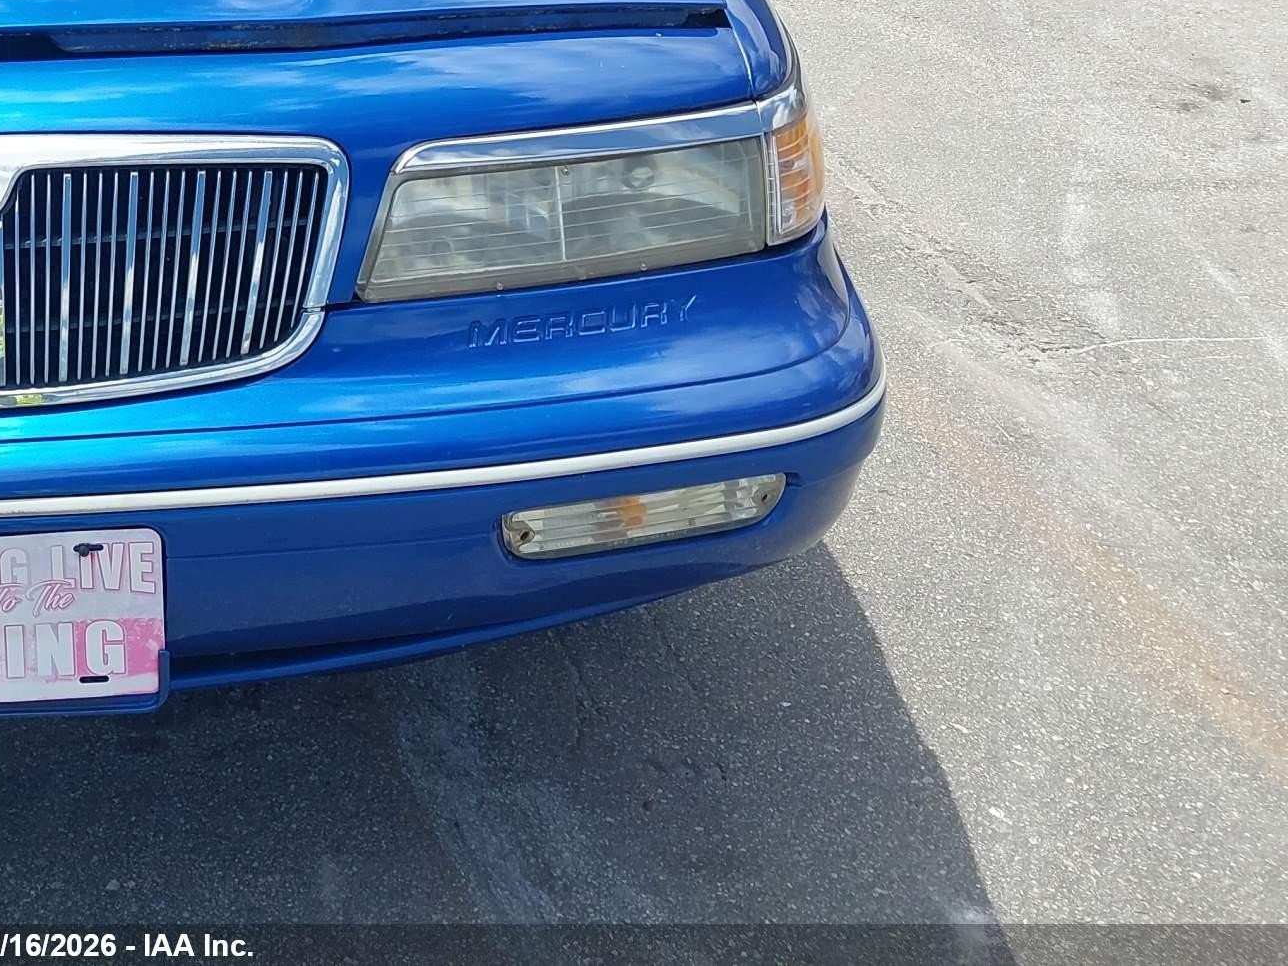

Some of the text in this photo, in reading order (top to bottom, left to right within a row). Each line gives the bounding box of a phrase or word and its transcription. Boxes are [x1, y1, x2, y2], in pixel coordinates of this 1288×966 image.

[469, 294, 697, 348] MERCURY
[49, 541, 158, 595] LIVE
[25, 581, 75, 619] The
